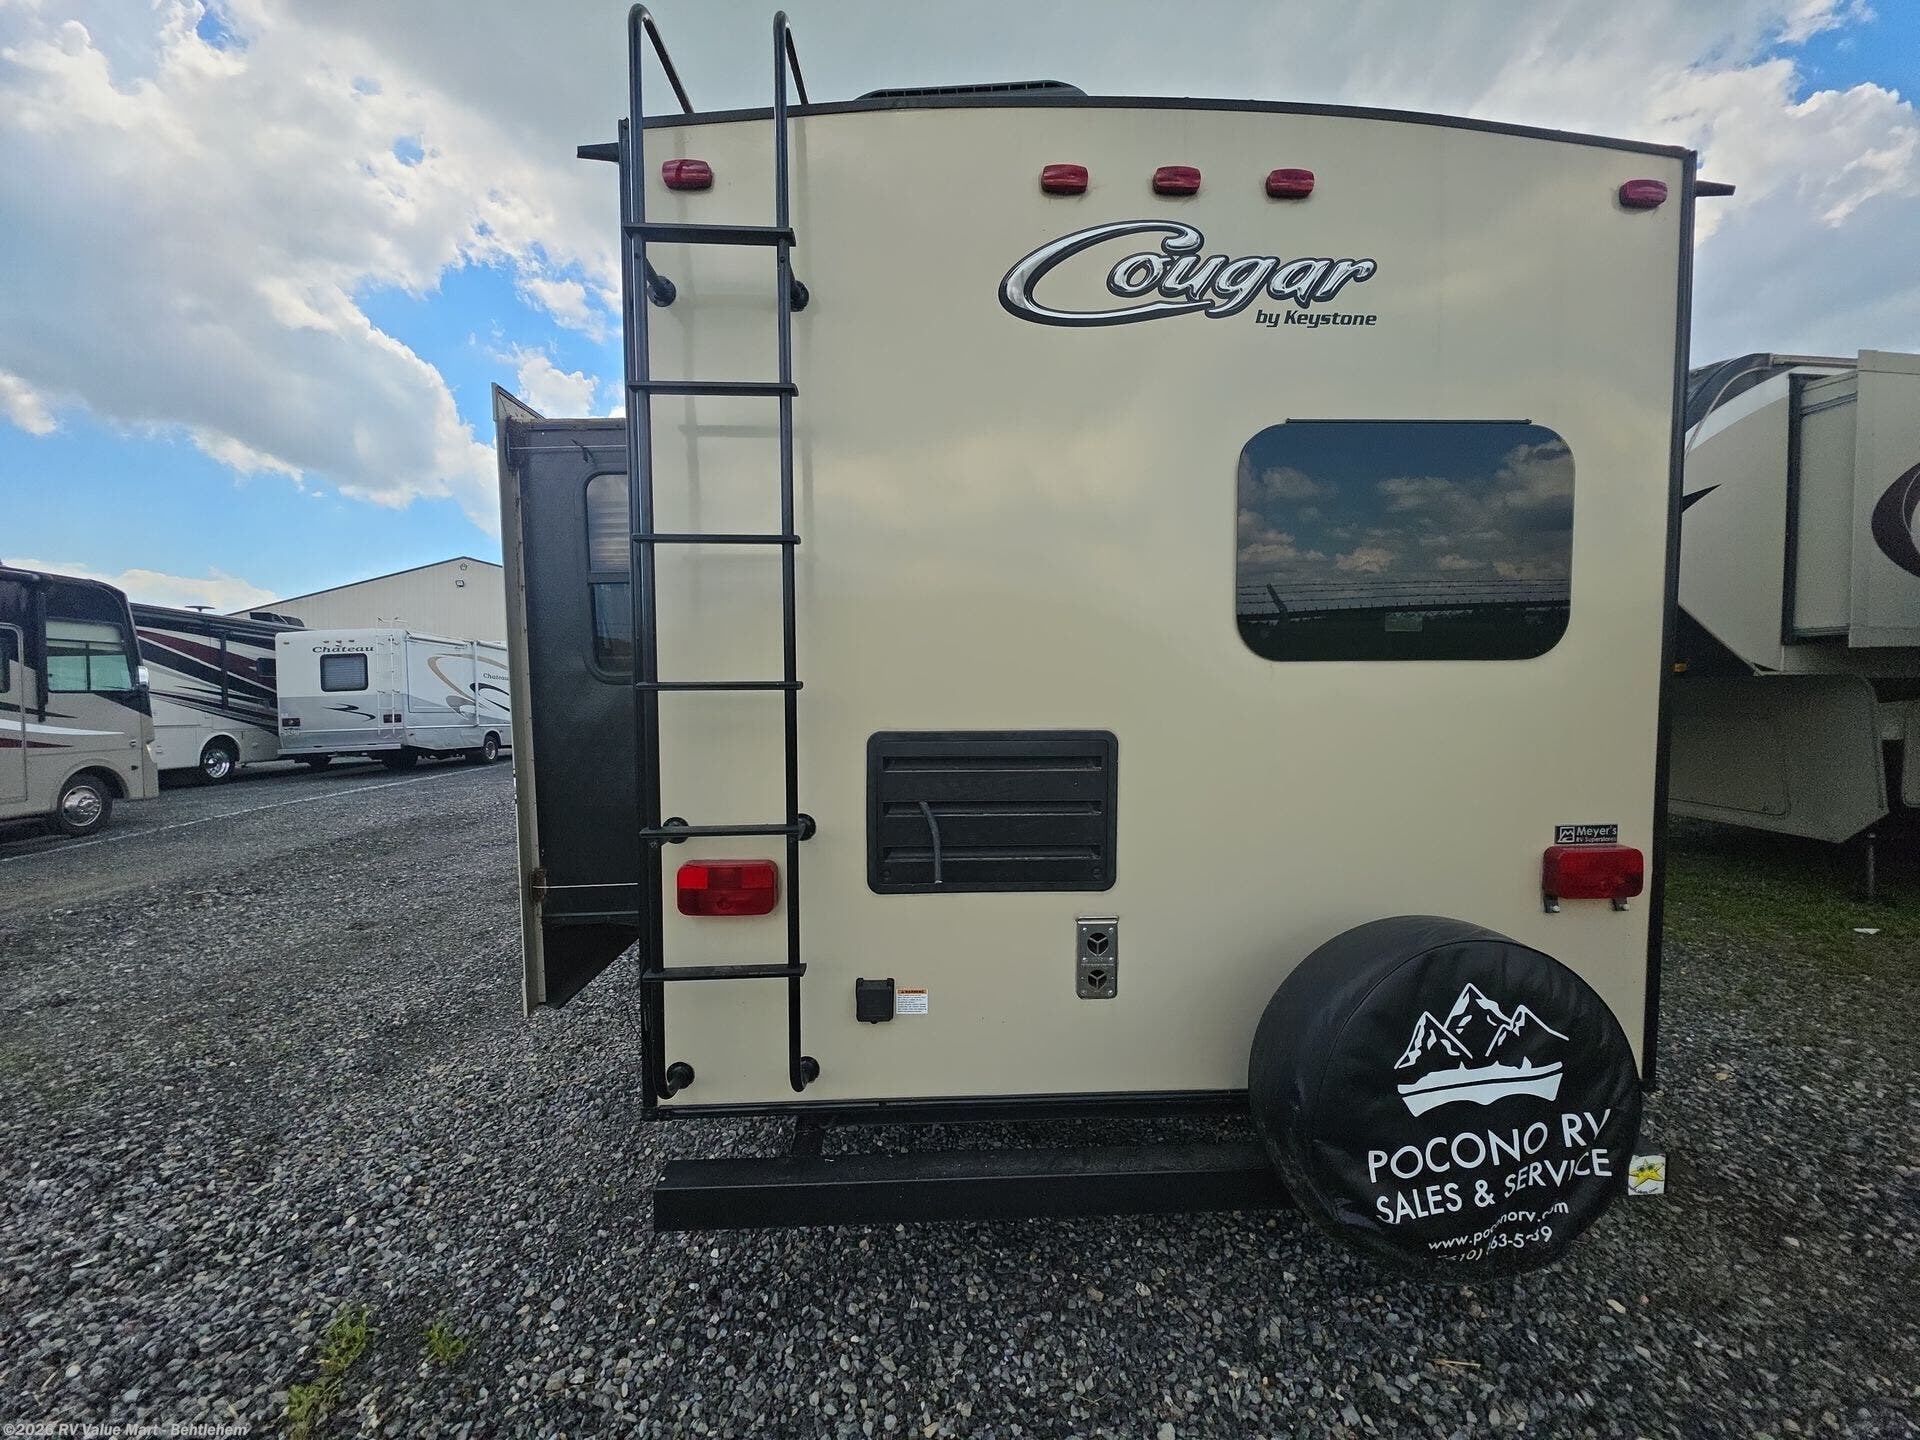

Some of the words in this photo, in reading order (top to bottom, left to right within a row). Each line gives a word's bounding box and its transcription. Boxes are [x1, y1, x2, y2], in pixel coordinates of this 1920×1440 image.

[999, 219, 1377, 327] Cougar
[1256, 310, 1277, 328] by
[1285, 311, 1377, 328] Keystone
[1576, 826, 1617, 837] Meyer's
[1368, 1121, 1549, 1183] POCONO
[1561, 1108, 1611, 1148] RV
[1376, 1182, 1463, 1224] SALES
[1473, 1179, 1496, 1208] &
[1504, 1148, 1613, 1199] SERVICE
